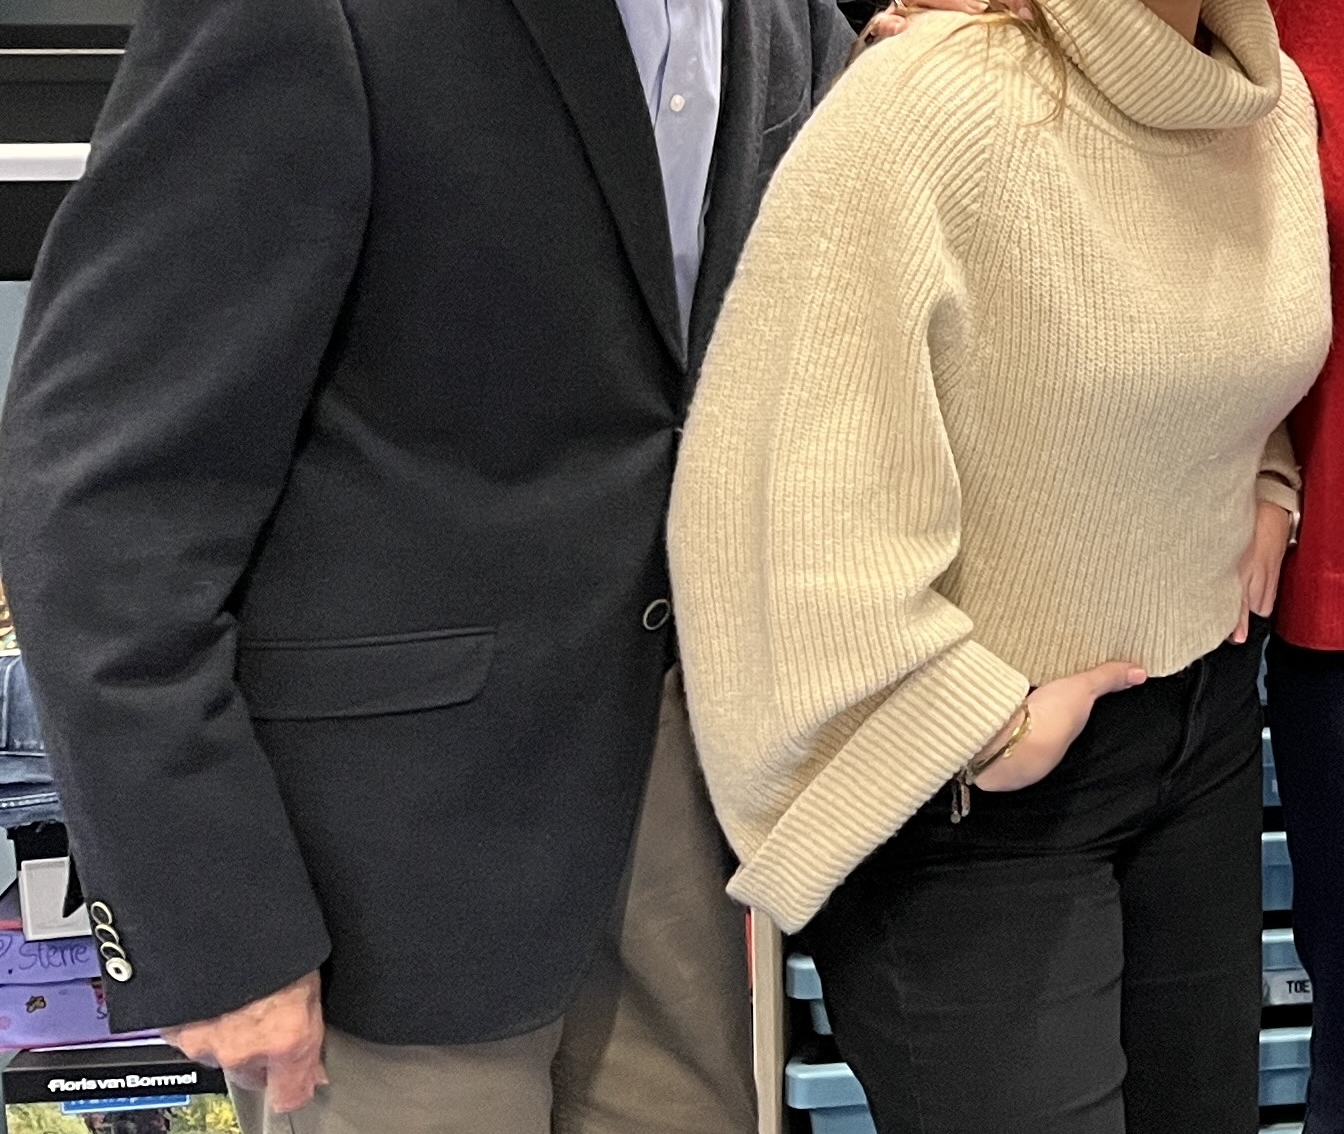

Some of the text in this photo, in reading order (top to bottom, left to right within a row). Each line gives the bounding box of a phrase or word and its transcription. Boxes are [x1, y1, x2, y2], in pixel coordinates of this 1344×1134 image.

[18, 939, 91, 970] Sterre
[48, 1077, 97, 1093] Floris
[126, 1071, 198, 1088] Bommel
